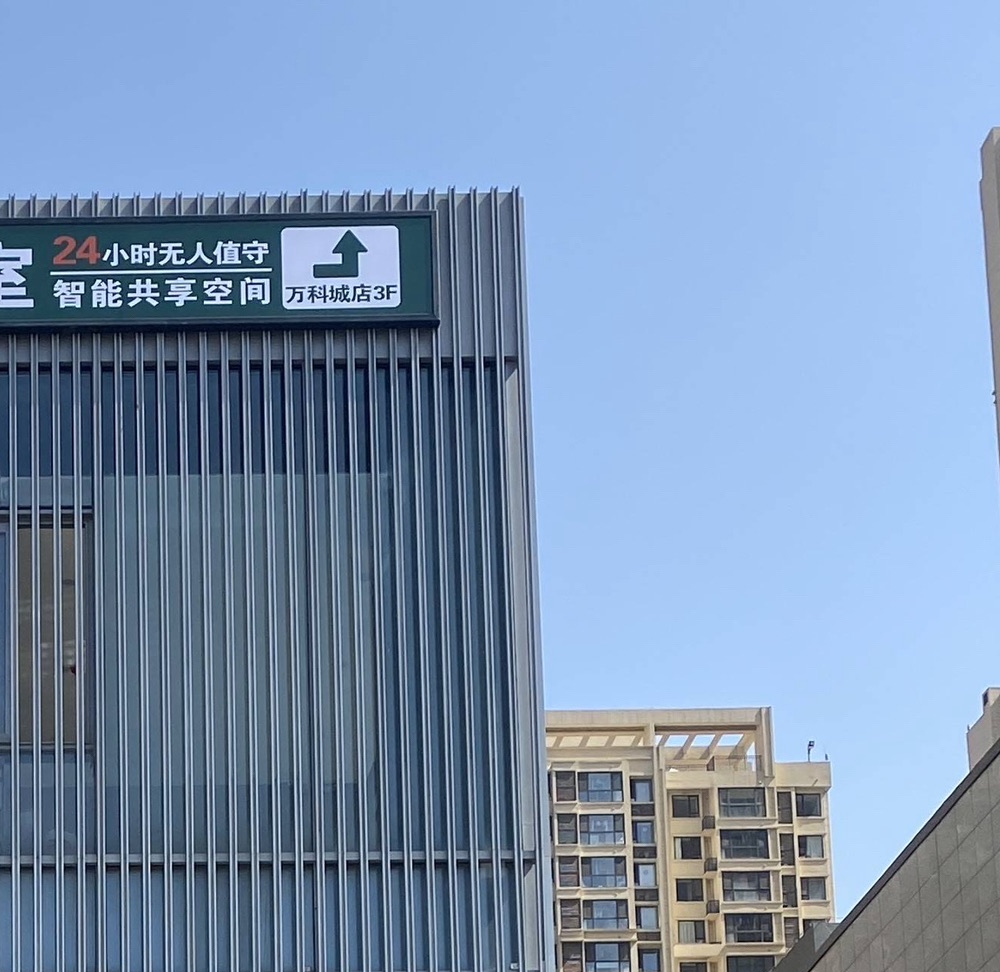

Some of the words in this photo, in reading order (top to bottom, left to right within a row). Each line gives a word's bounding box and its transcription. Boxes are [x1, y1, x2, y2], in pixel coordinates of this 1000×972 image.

[52, 235, 270, 268] 24小时无人值守
[52, 277, 271, 309] 智能共享空间
[285, 284, 398, 304] 万科城店3F
